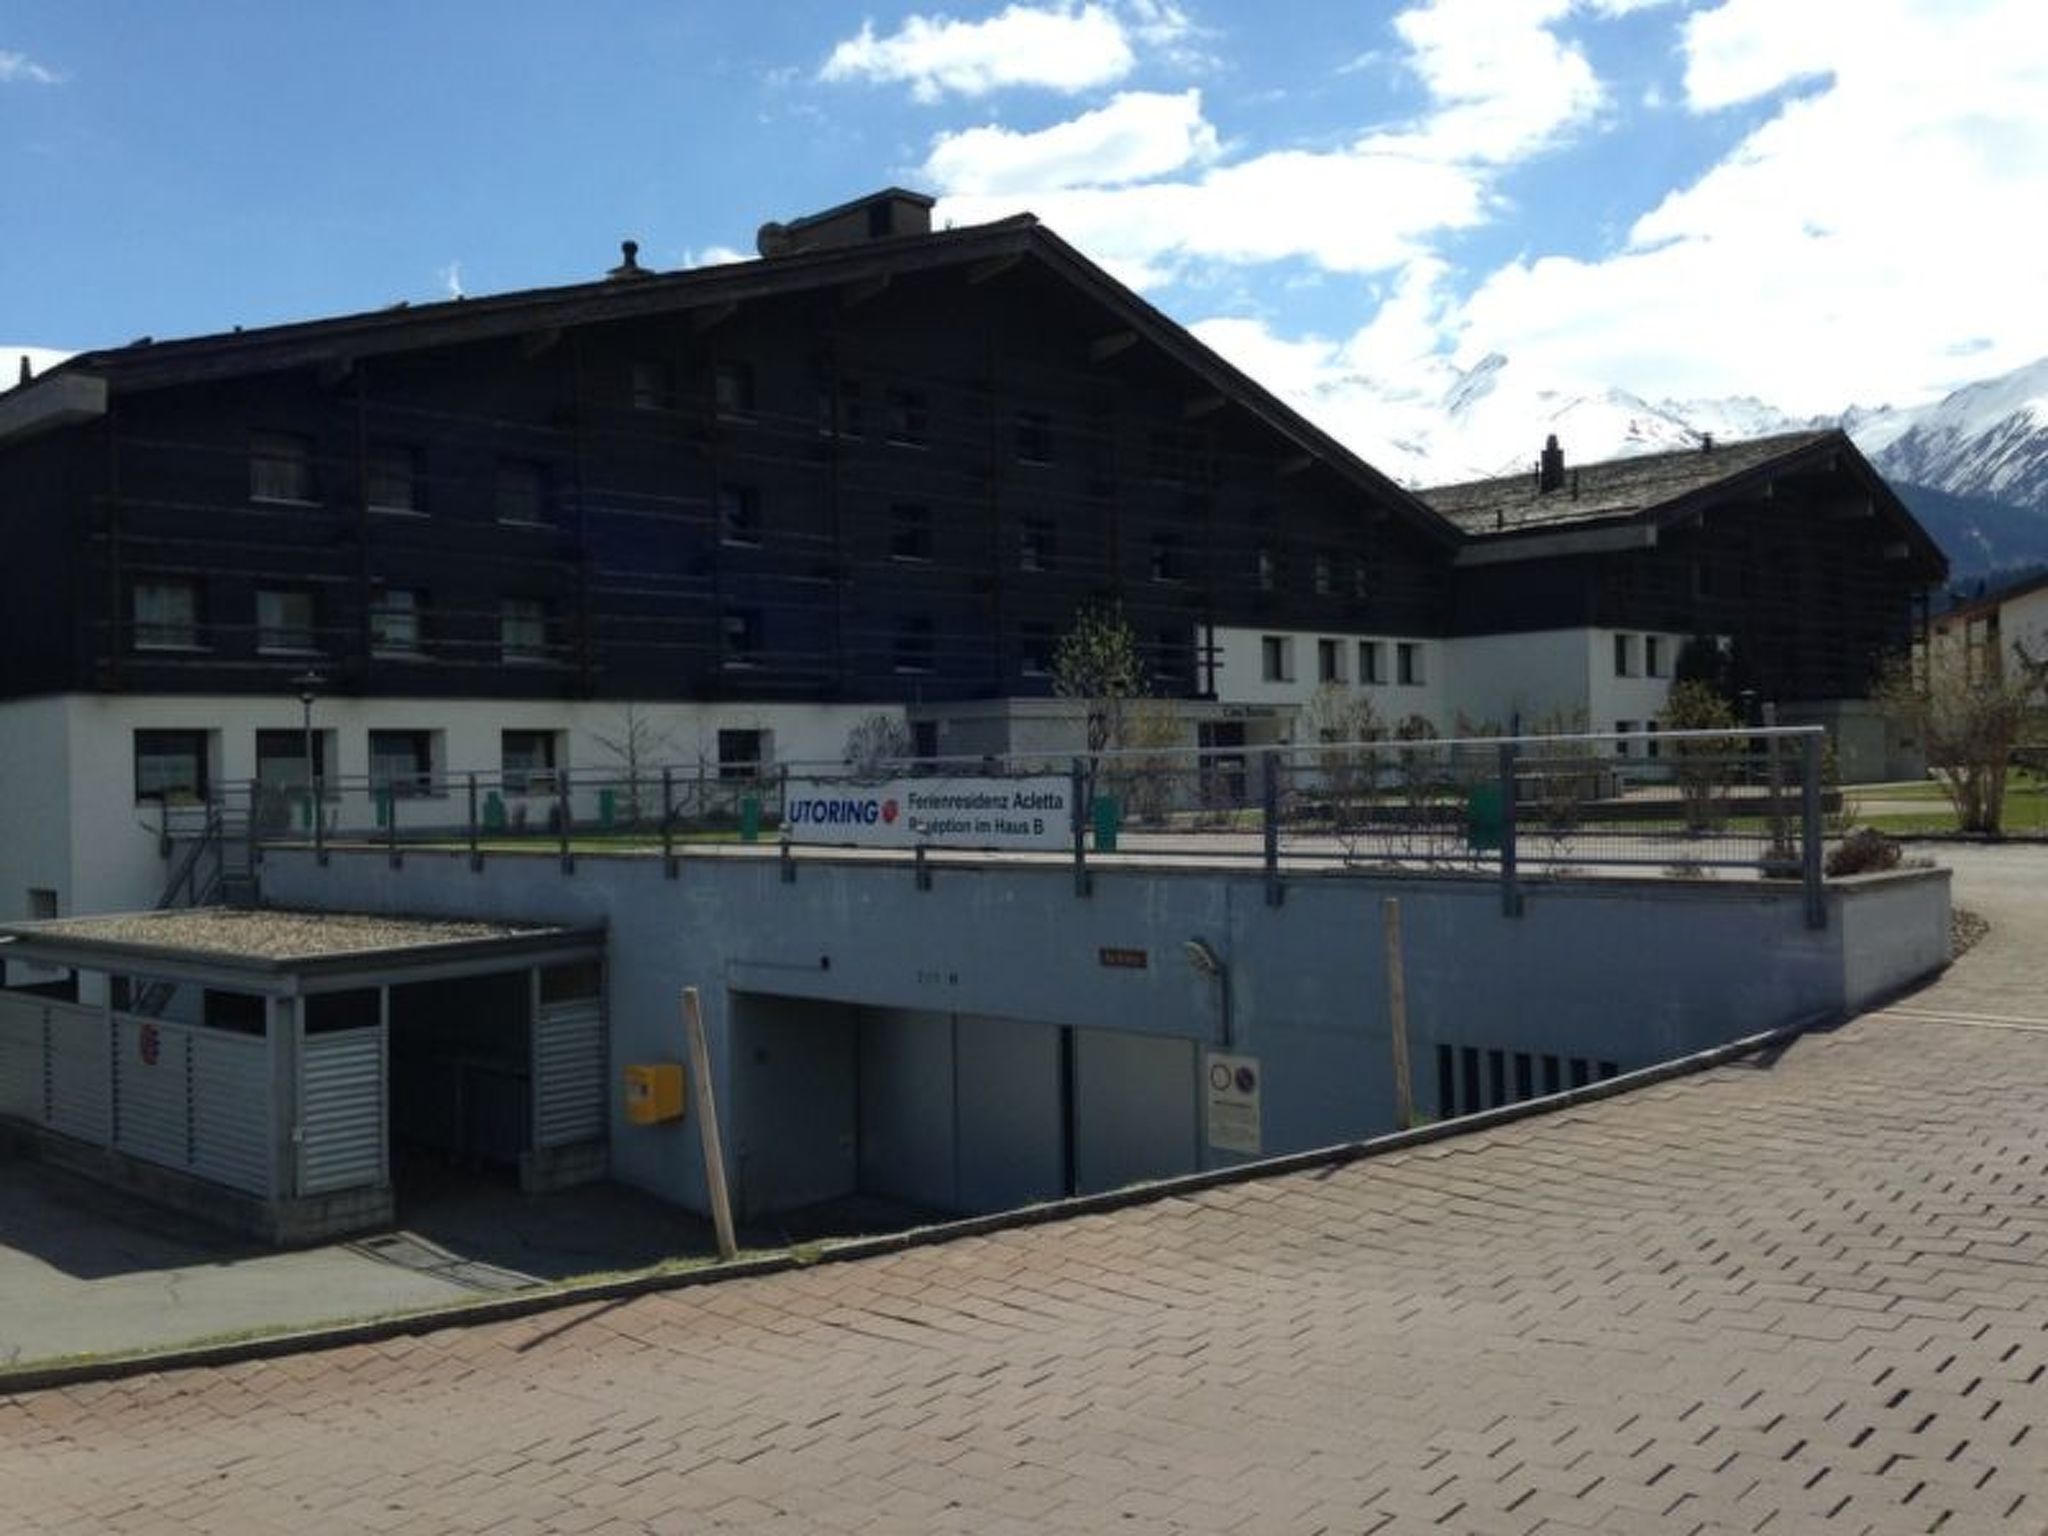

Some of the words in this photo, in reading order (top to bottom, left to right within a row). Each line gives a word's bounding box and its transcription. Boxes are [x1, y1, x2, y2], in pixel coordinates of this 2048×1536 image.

[907, 792, 1008, 809] Ferienresidenz
[789, 799, 879, 824] UTORING
[974, 818, 992, 833] im
[994, 818, 1030, 835] Haus
[1032, 818, 1046, 836] B
